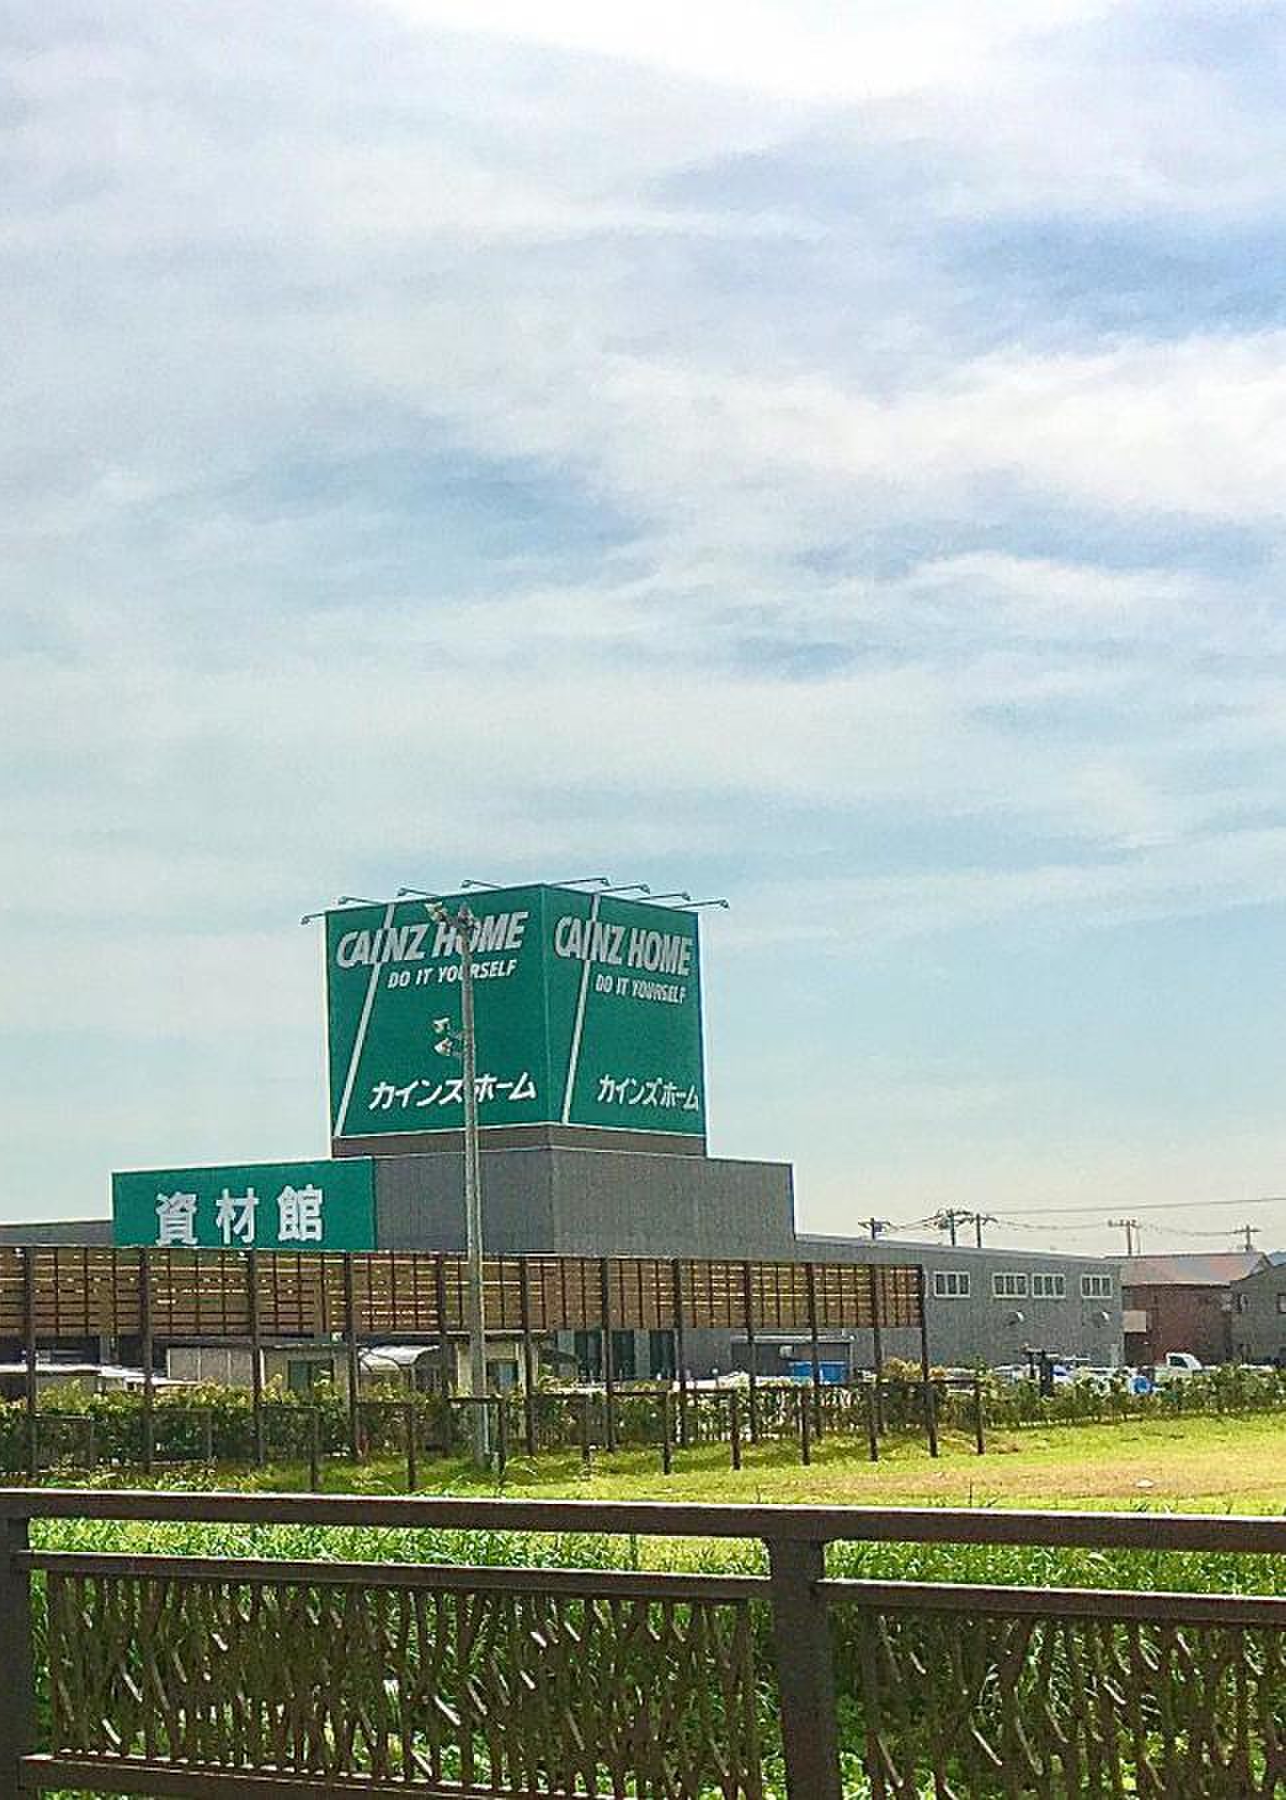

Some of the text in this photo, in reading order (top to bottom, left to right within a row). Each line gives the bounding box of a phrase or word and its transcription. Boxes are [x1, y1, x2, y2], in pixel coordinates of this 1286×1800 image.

[336, 911, 529, 967] CAINZ HOME
[555, 916, 693, 976] CAINZ HOME
[387, 971, 411, 989] DO
[415, 967, 434, 986] IT
[595, 973, 687, 1005] DO IT YOURSELF
[597, 1073, 699, 1112] カインズホーム
[155, 1183, 324, 1246] 資材館
